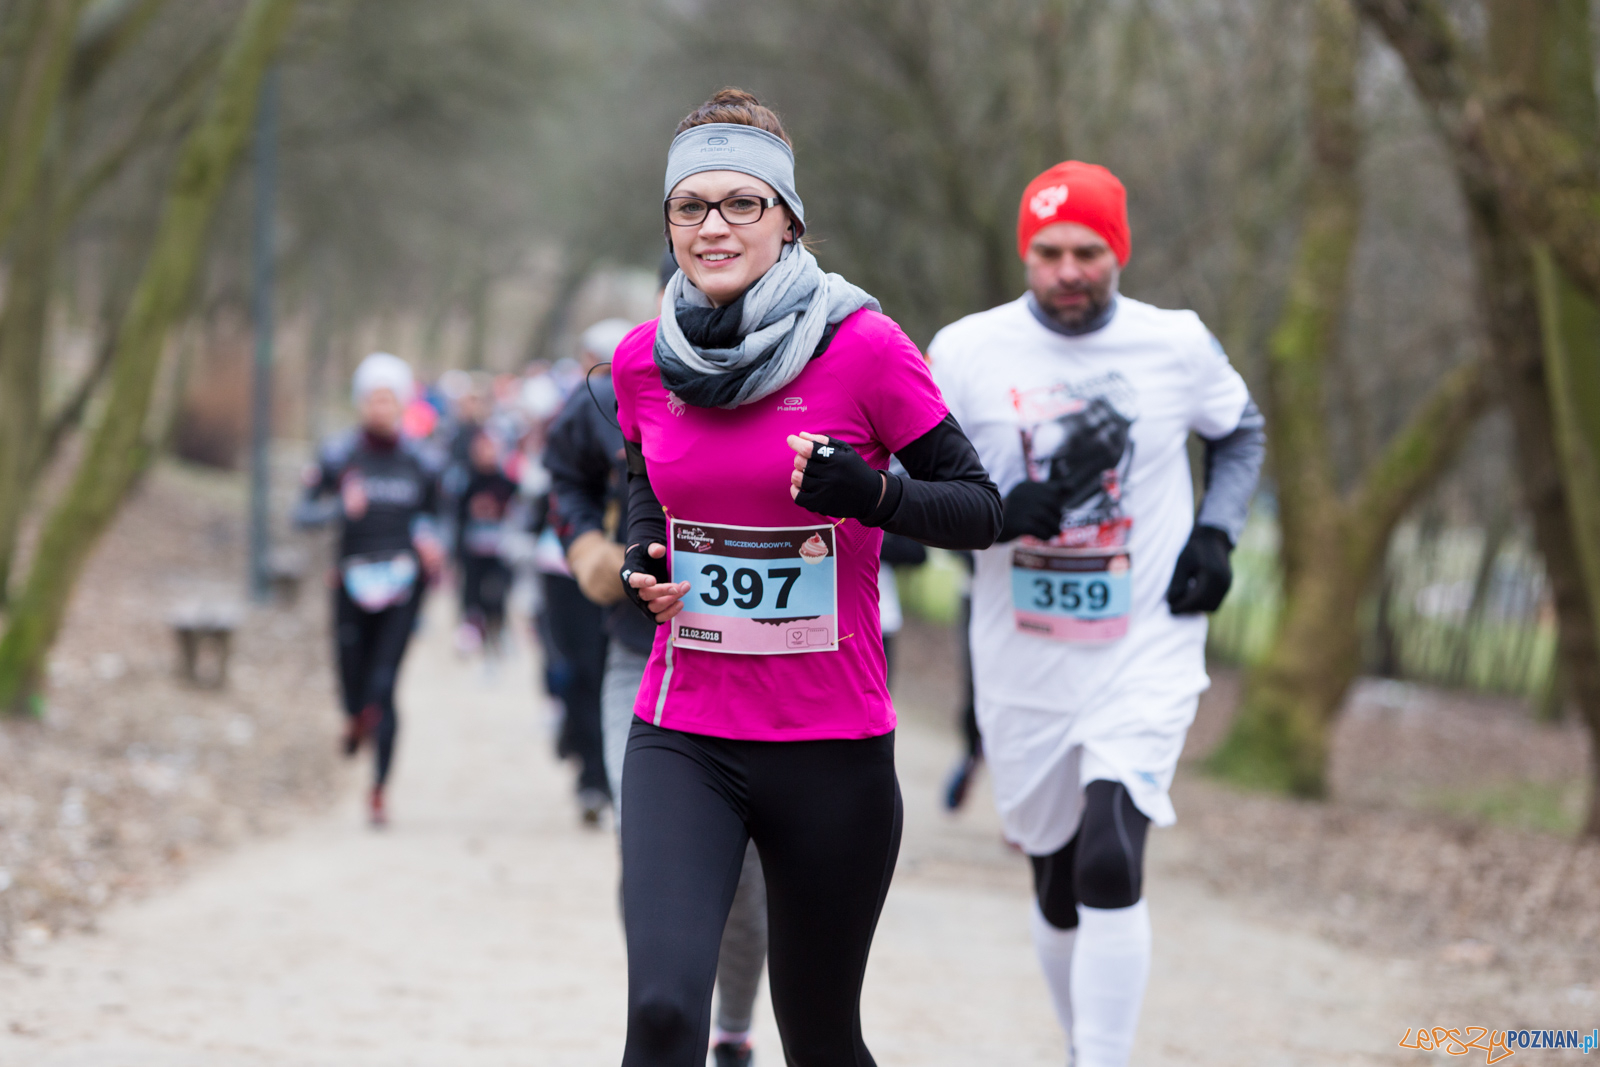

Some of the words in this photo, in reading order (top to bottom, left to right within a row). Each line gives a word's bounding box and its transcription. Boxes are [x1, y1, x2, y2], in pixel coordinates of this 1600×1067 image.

[817, 446, 835, 457] 4F
[724, 539, 792, 549] BIEGCZEKOLADOWY.PL
[699, 564, 801, 610] 397
[1032, 578, 1110, 611] 359
[680, 628, 720, 642] 11.02.2018
